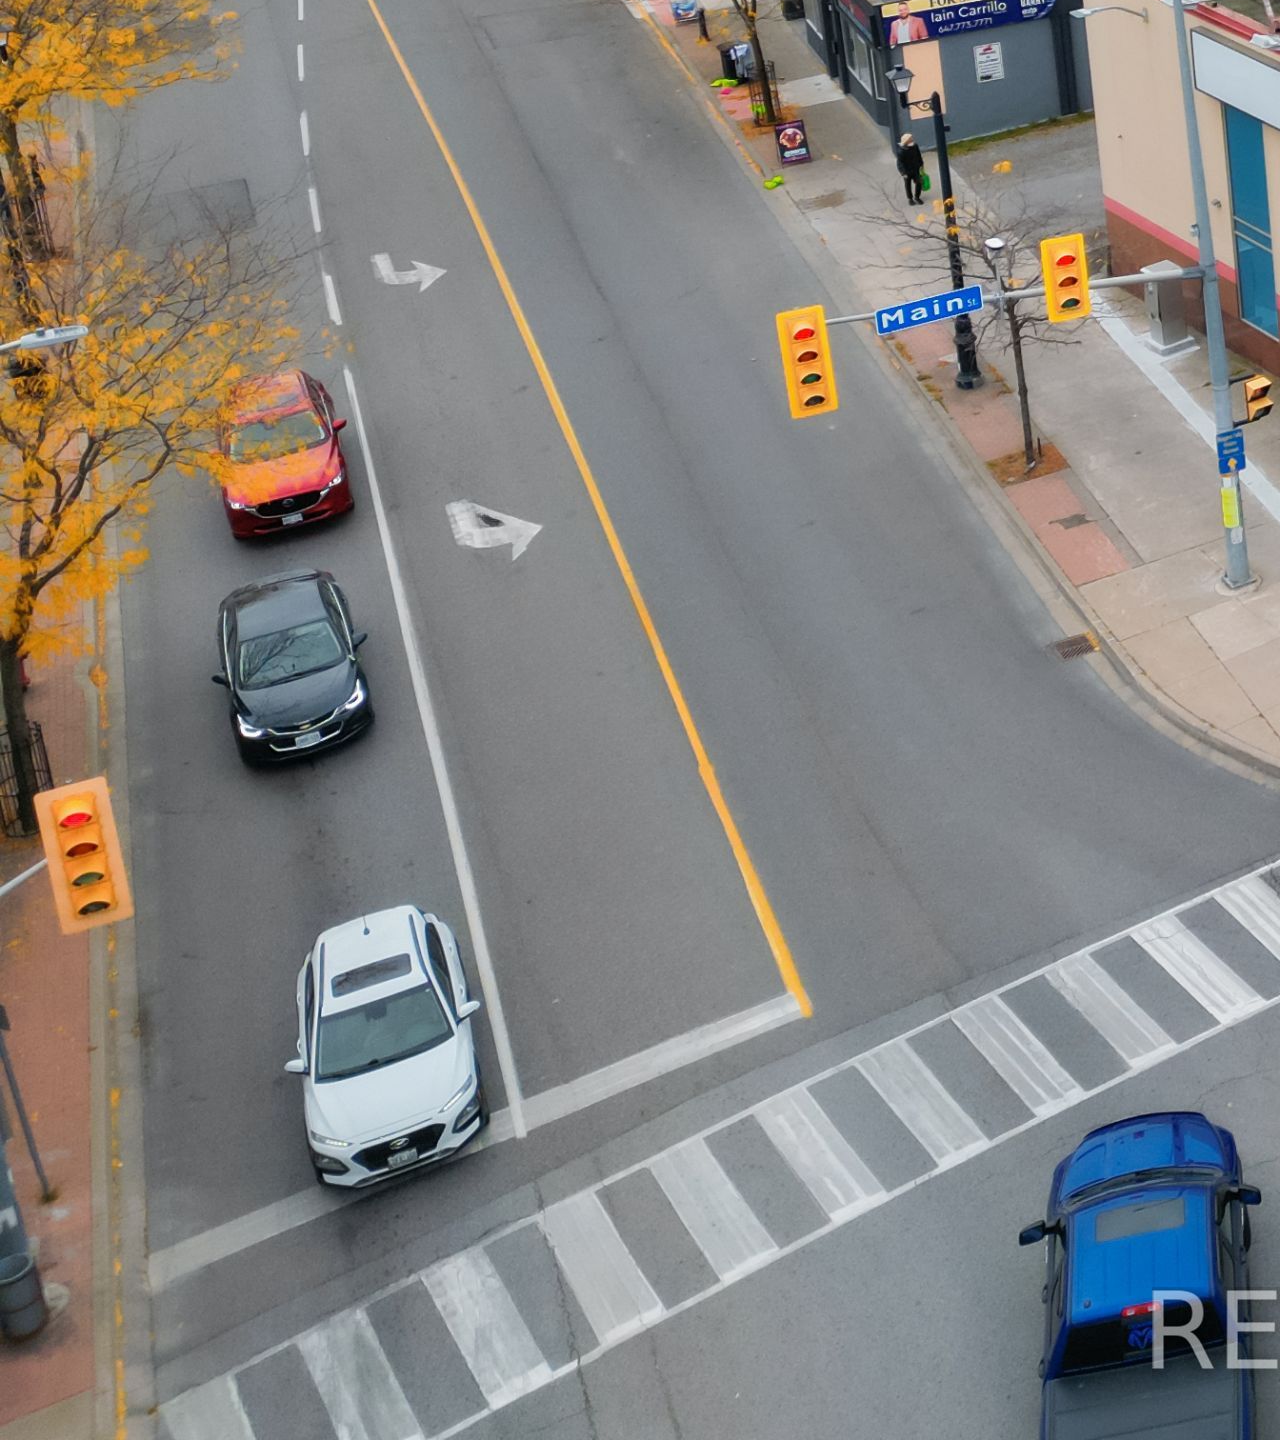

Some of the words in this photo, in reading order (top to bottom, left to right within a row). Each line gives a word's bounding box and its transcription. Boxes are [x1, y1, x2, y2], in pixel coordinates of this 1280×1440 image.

[930, 9, 955, 23] Iain
[958, 0, 1007, 17] Carrillo
[881, 297, 964, 328] Main
